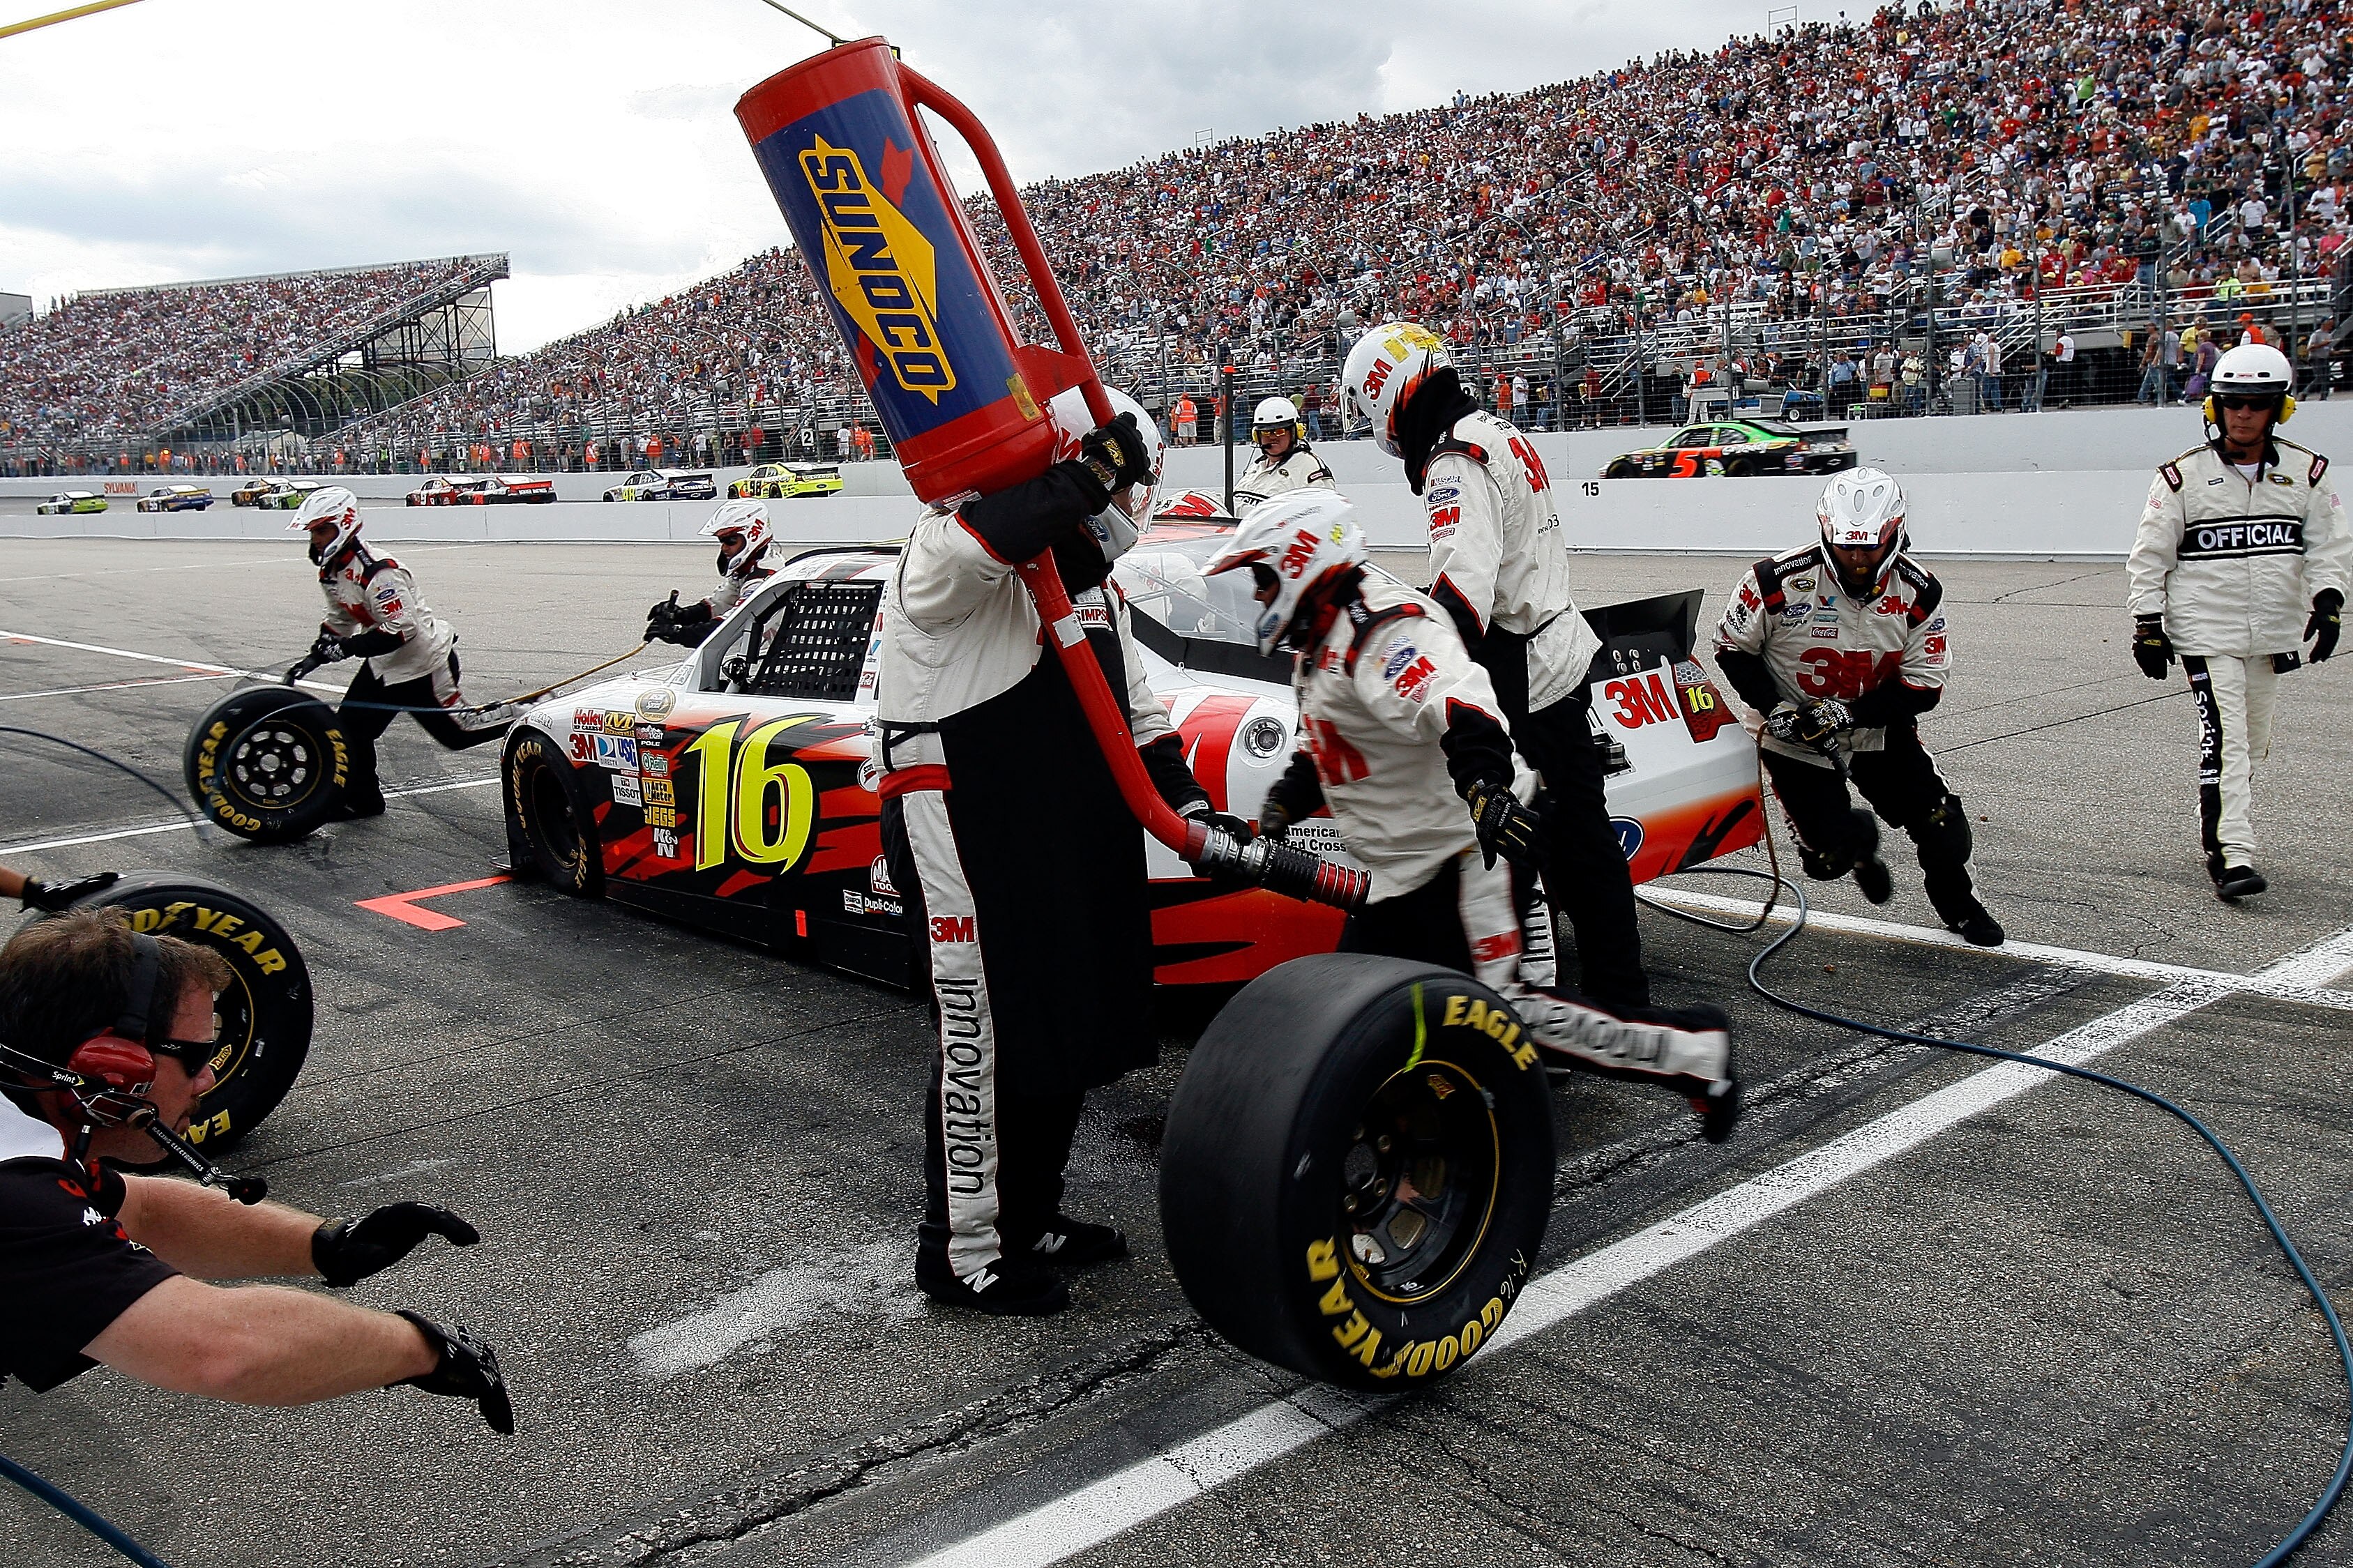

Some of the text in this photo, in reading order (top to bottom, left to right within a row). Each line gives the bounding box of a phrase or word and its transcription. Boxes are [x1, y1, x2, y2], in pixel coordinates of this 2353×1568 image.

[803, 153, 950, 386] SUNOCO
[1361, 358, 1393, 401] 3M
[803, 431, 812, 444] 2
[1669, 450, 1700, 478] 5
[105, 481, 136, 495] SYLVANIA
[750, 480, 762, 496] 98
[1432, 489, 1453, 501] Ford
[1582, 482, 1599, 496] 15
[340, 506, 356, 531] 3M
[747, 517, 765, 543] 3M
[1087, 519, 1103, 539] Ford
[1430, 506, 1460, 531] 3M
[1845, 531, 1868, 541] 3M
[2197, 525, 2295, 549] OFFICIAL
[1281, 528, 1321, 580] 3M
[1773, 554, 1813, 576] Innovation
[381, 598, 403, 615] 3M
[1739, 583, 1762, 614] 3M
[1875, 595, 1912, 615] 3M
[1075, 609, 1110, 623] SIMPS
[1395, 656, 1437, 698] 3M
[1796, 646, 1907, 698] 3M
[1604, 673, 1681, 729] 3M
[1685, 685, 1714, 713] 16
[573, 709, 604, 729] Holley
[2195, 690, 2216, 758] Sprint
[325, 729, 349, 789] EAGLE
[568, 733, 598, 761] 3M
[618, 737, 637, 768] USG
[614, 786, 640, 800] TISSOT
[652, 781, 668, 792] Auto
[652, 791, 672, 802] Meter
[684, 715, 823, 876] 16
[644, 805, 676, 828] JEGS
[1309, 839, 1347, 852] Cross
[873, 858, 891, 883] MA
[931, 916, 975, 943] 3M
[1442, 996, 1538, 1072] EAGLE
[52, 1070, 76, 1085] Sprint
[933, 977, 987, 1194] Innovation
[151, 1125, 172, 1145] RACING
[170, 1142, 205, 1173] ELECTRONICS
[1306, 1238, 1505, 1379] GOODYEAR
